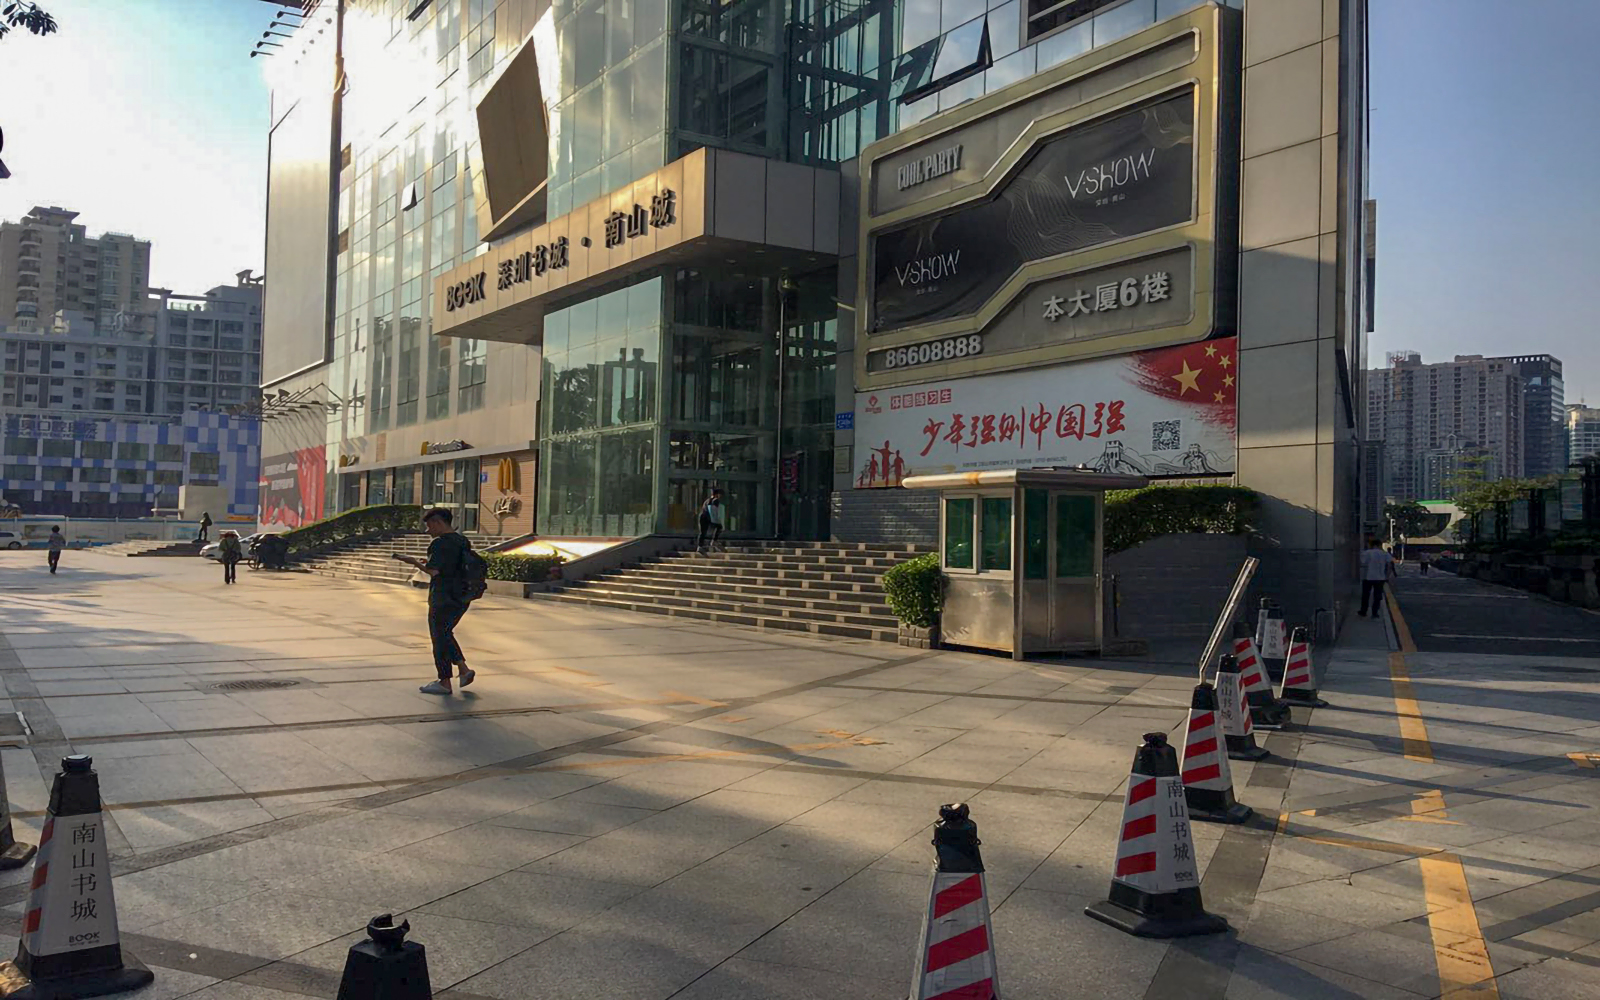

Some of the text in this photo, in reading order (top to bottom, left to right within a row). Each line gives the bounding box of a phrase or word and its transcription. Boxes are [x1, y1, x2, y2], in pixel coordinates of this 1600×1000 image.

[897, 144, 964, 191] COOL PARTY
[446, 271, 487, 312] BOOK
[1042, 270, 1170, 322] 本大厦6楼
[885, 334, 983, 368] 86608888
[920, 400, 1126, 457] 少年强则中国强
[1166, 780, 1190, 862] 南山书城
[70, 822, 98, 923] 南山书城
[68, 931, 101, 943] BOOK
